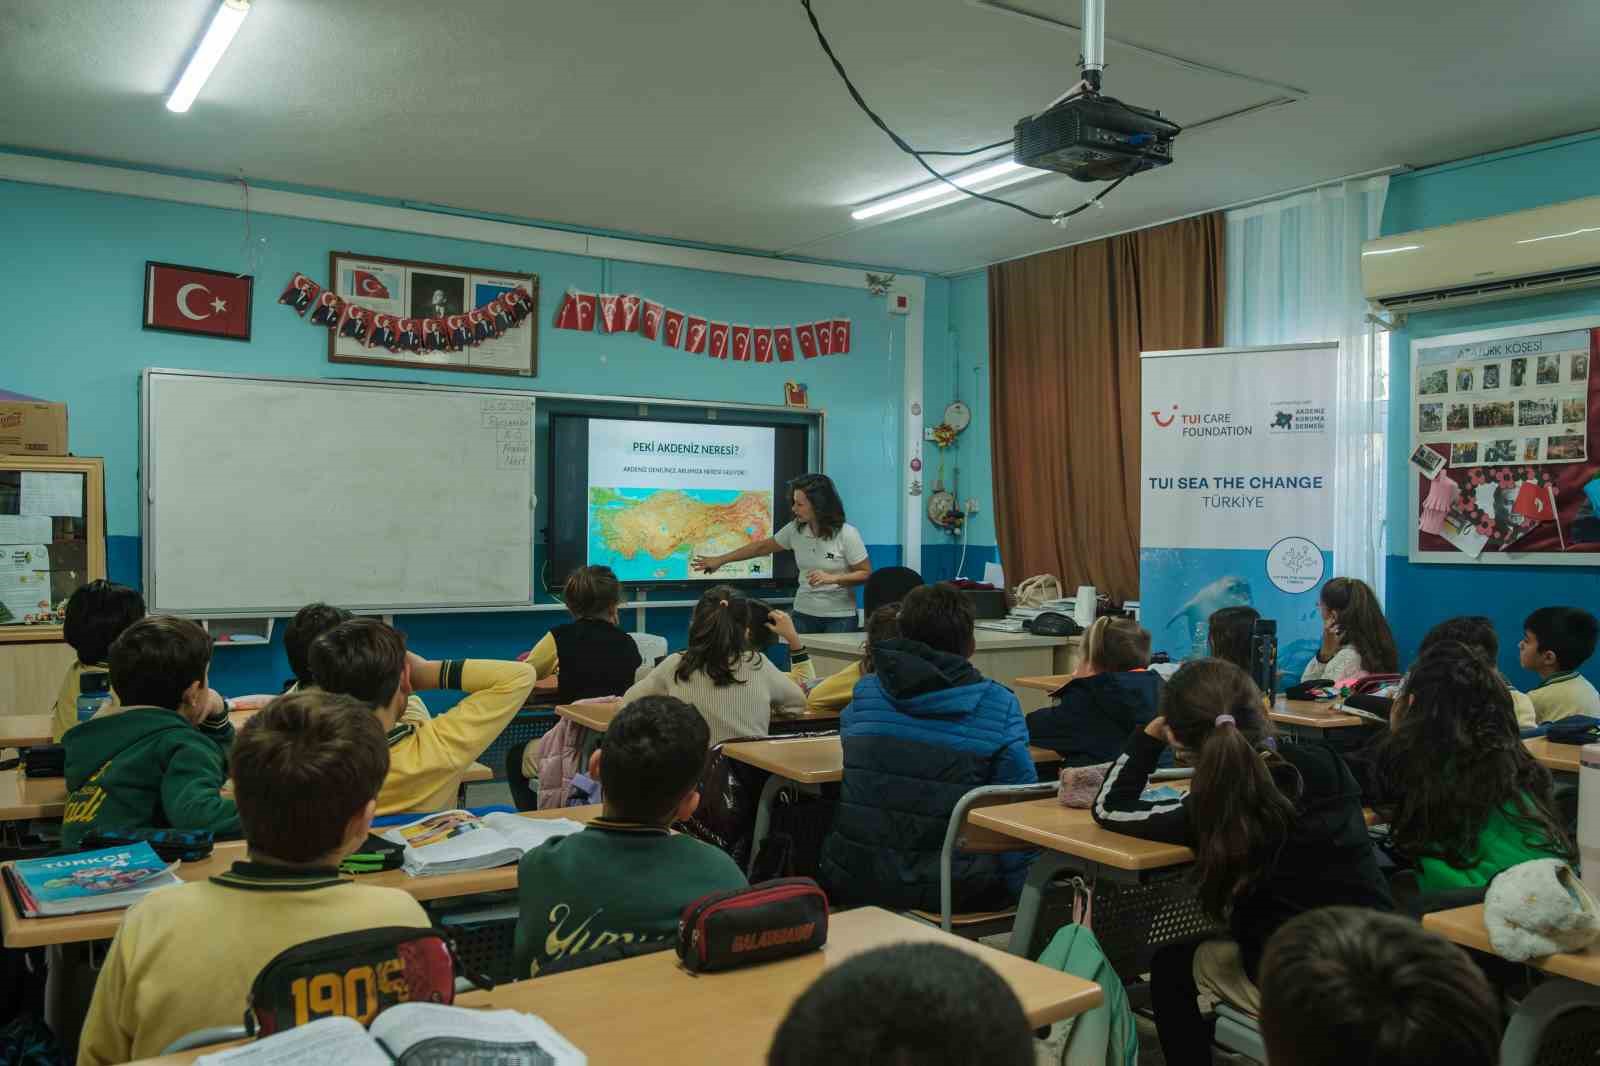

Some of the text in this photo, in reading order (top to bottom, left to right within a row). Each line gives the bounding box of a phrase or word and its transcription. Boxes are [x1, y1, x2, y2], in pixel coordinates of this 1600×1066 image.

[1182, 413, 1231, 425] TUI CARE
[1182, 425, 1253, 437] FOUNDATION
[632, 441, 740, 456] PEKİ AKDENİZ NERESİ?
[1149, 476, 1322, 489] TUI SEA THE CHANGE
[1202, 494, 1264, 508] TÜRKİYE
